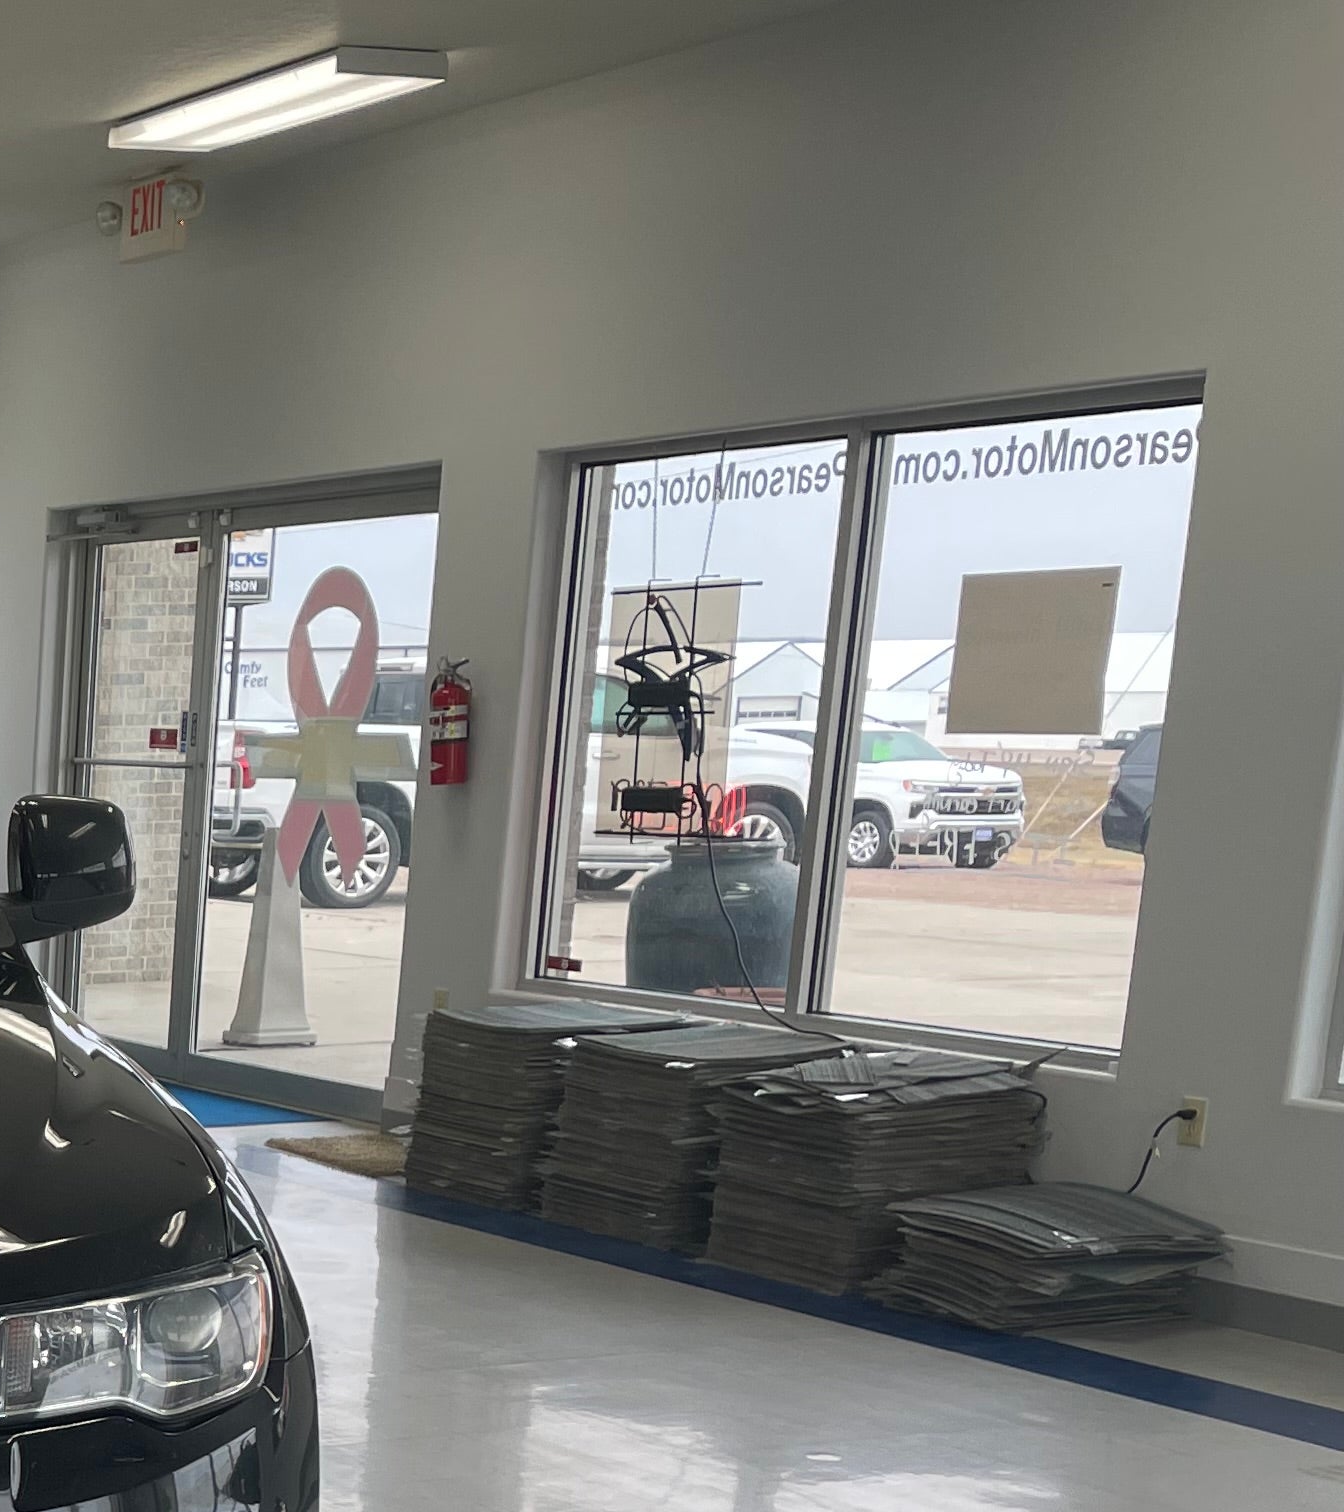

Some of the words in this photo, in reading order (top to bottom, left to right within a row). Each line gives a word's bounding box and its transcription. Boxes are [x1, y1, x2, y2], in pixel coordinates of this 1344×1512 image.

[130, 179, 166, 237] EXIT
[224, 661, 262, 674] Cmfy
[243, 674, 268, 688] Feet
